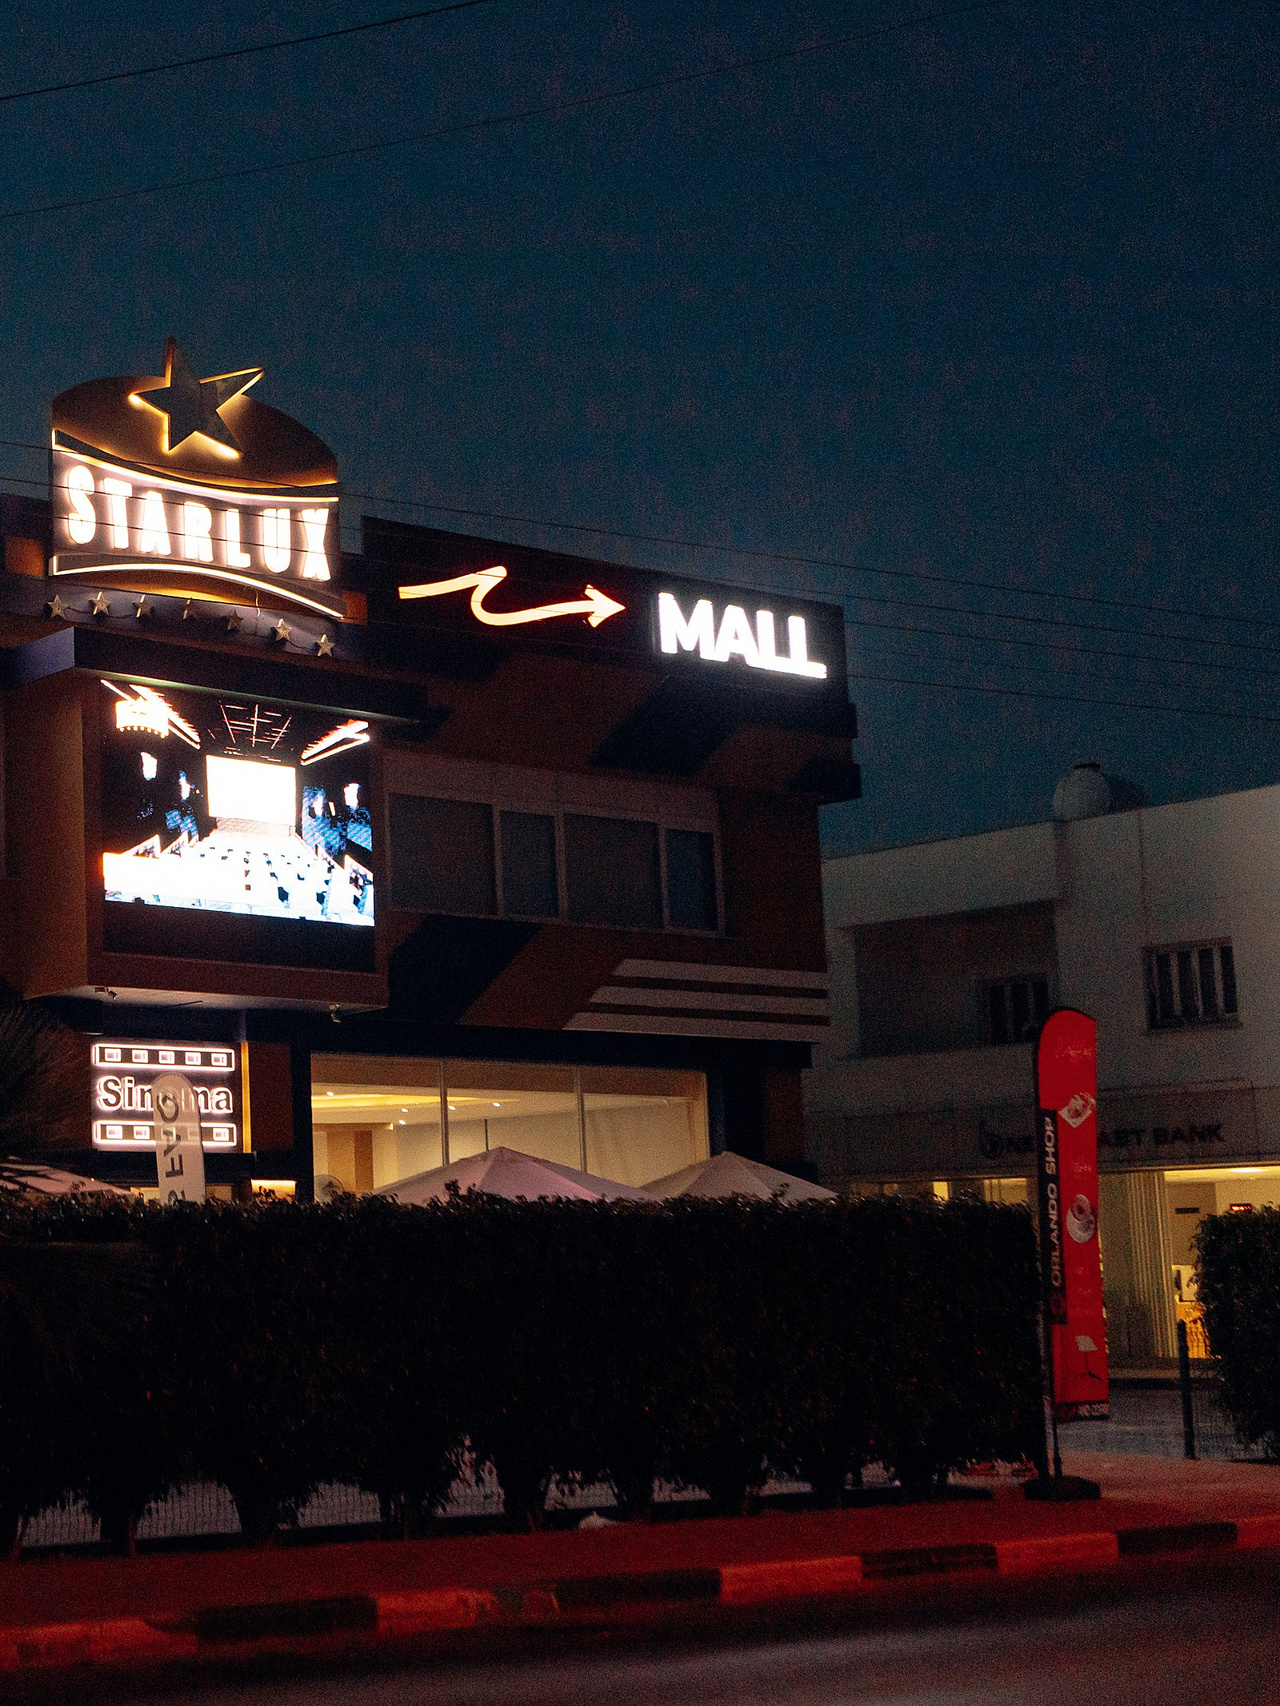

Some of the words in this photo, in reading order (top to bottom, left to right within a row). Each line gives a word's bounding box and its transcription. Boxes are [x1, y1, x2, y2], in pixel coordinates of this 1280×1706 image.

[68, 464, 332, 581] STARLUX
[658, 592, 827, 679] MALL
[97, 1075, 234, 1114] Sinma
[1044, 1116, 1057, 1176] SHOP
[1098, 1128, 1146, 1148] AST
[1152, 1123, 1225, 1145] BANK
[1047, 1182, 1062, 1287] ORLANDO
